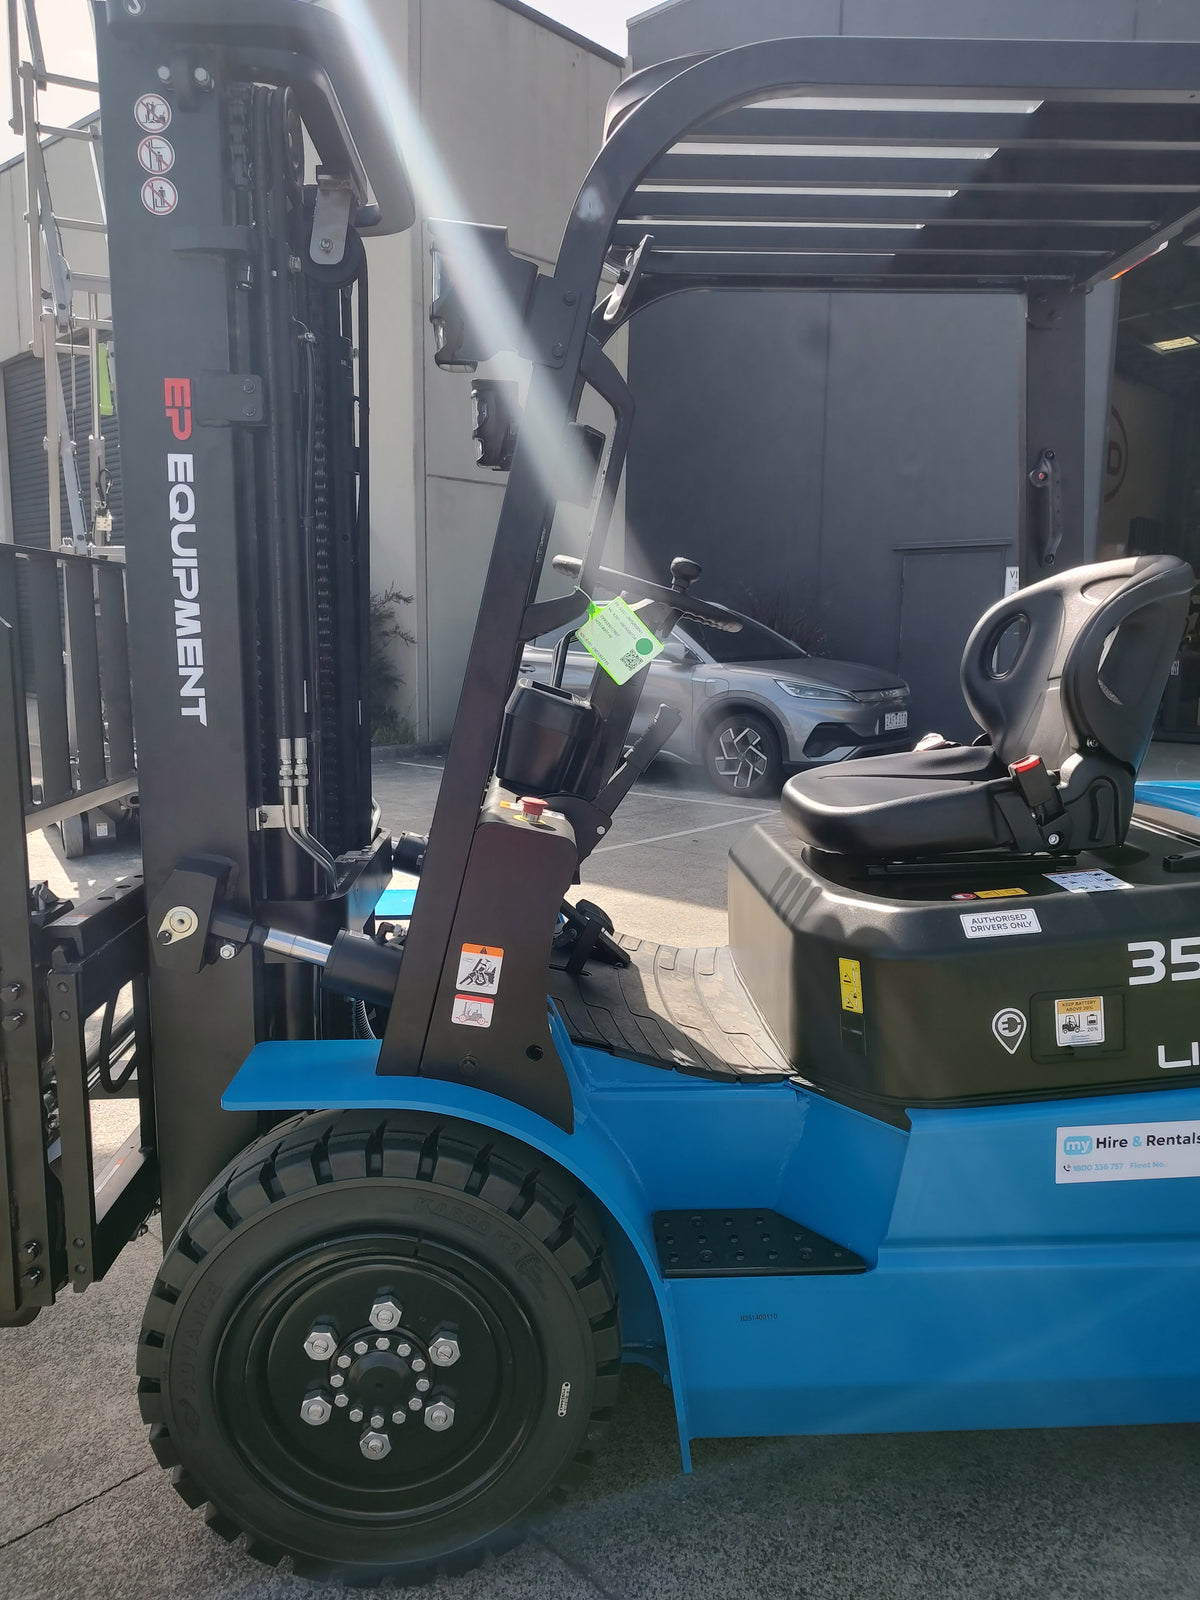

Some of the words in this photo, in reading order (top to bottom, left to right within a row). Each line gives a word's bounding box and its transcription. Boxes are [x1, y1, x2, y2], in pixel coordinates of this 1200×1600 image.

[164, 378, 192, 440] EP
[167, 453, 208, 727] EQUIPMENT
[970, 923, 1008, 933] DRIVERS
[1010, 921, 1033, 929] ONLY
[971, 914, 1026, 925] AUTHORISED
[1066, 1140, 1091, 1153] my
[1096, 1136, 1128, 1149] Hire
[1132, 1135, 1142, 1147] &
[1146, 1132, 1200, 1146] Rentals
